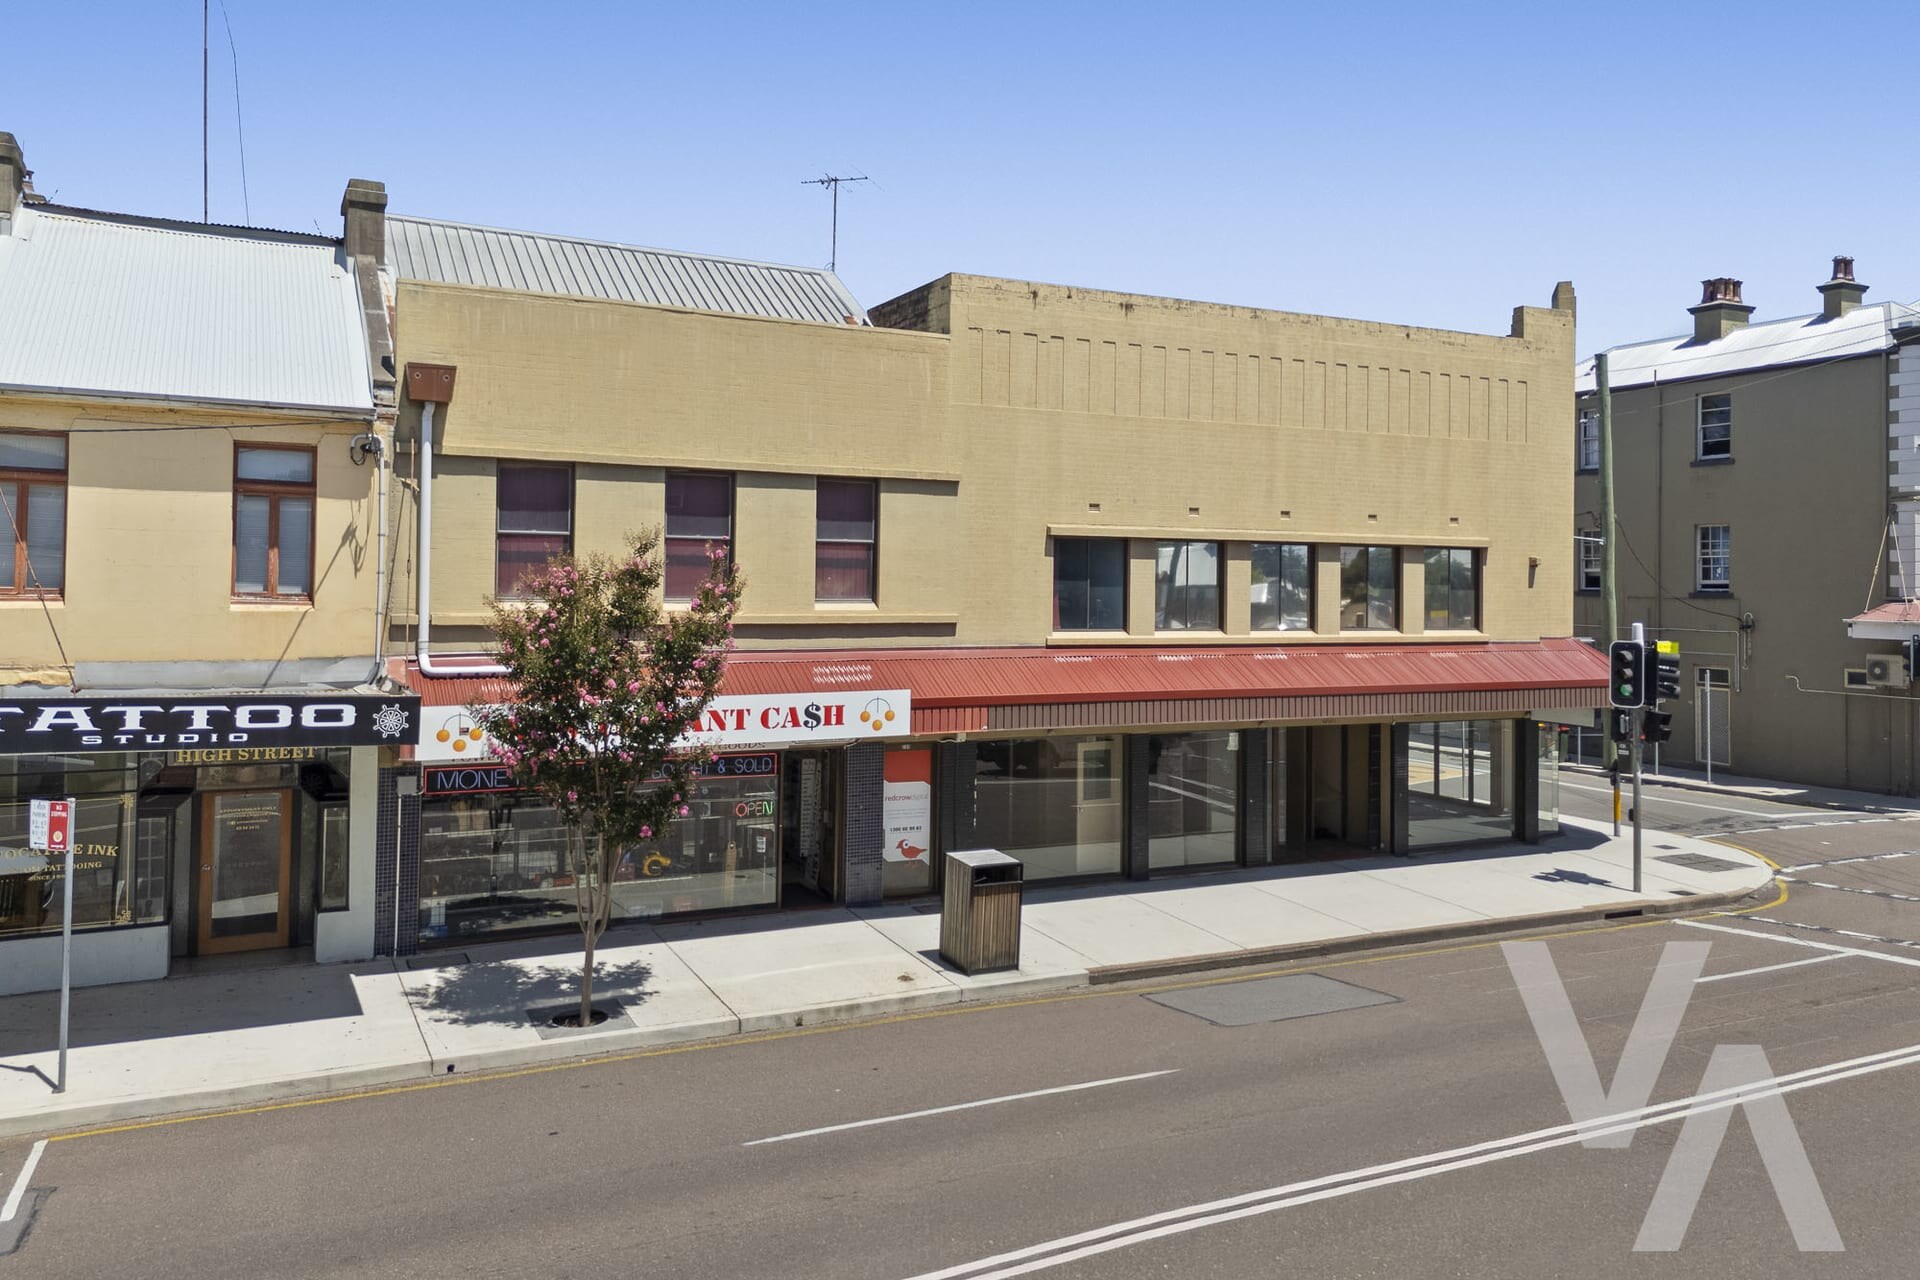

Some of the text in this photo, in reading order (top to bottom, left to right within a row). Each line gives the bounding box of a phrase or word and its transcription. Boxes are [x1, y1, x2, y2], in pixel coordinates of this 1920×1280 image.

[760, 702, 844, 731] CA$H
[81, 733, 248, 745] STUDIO
[177, 746, 317, 763] HIGH STREET
[717, 763, 726, 774] &
[734, 757, 772, 774] SOLD
[735, 801, 774, 817] OPEN
[87, 843, 120, 857] INK
[44, 861, 102, 873] TATOING
